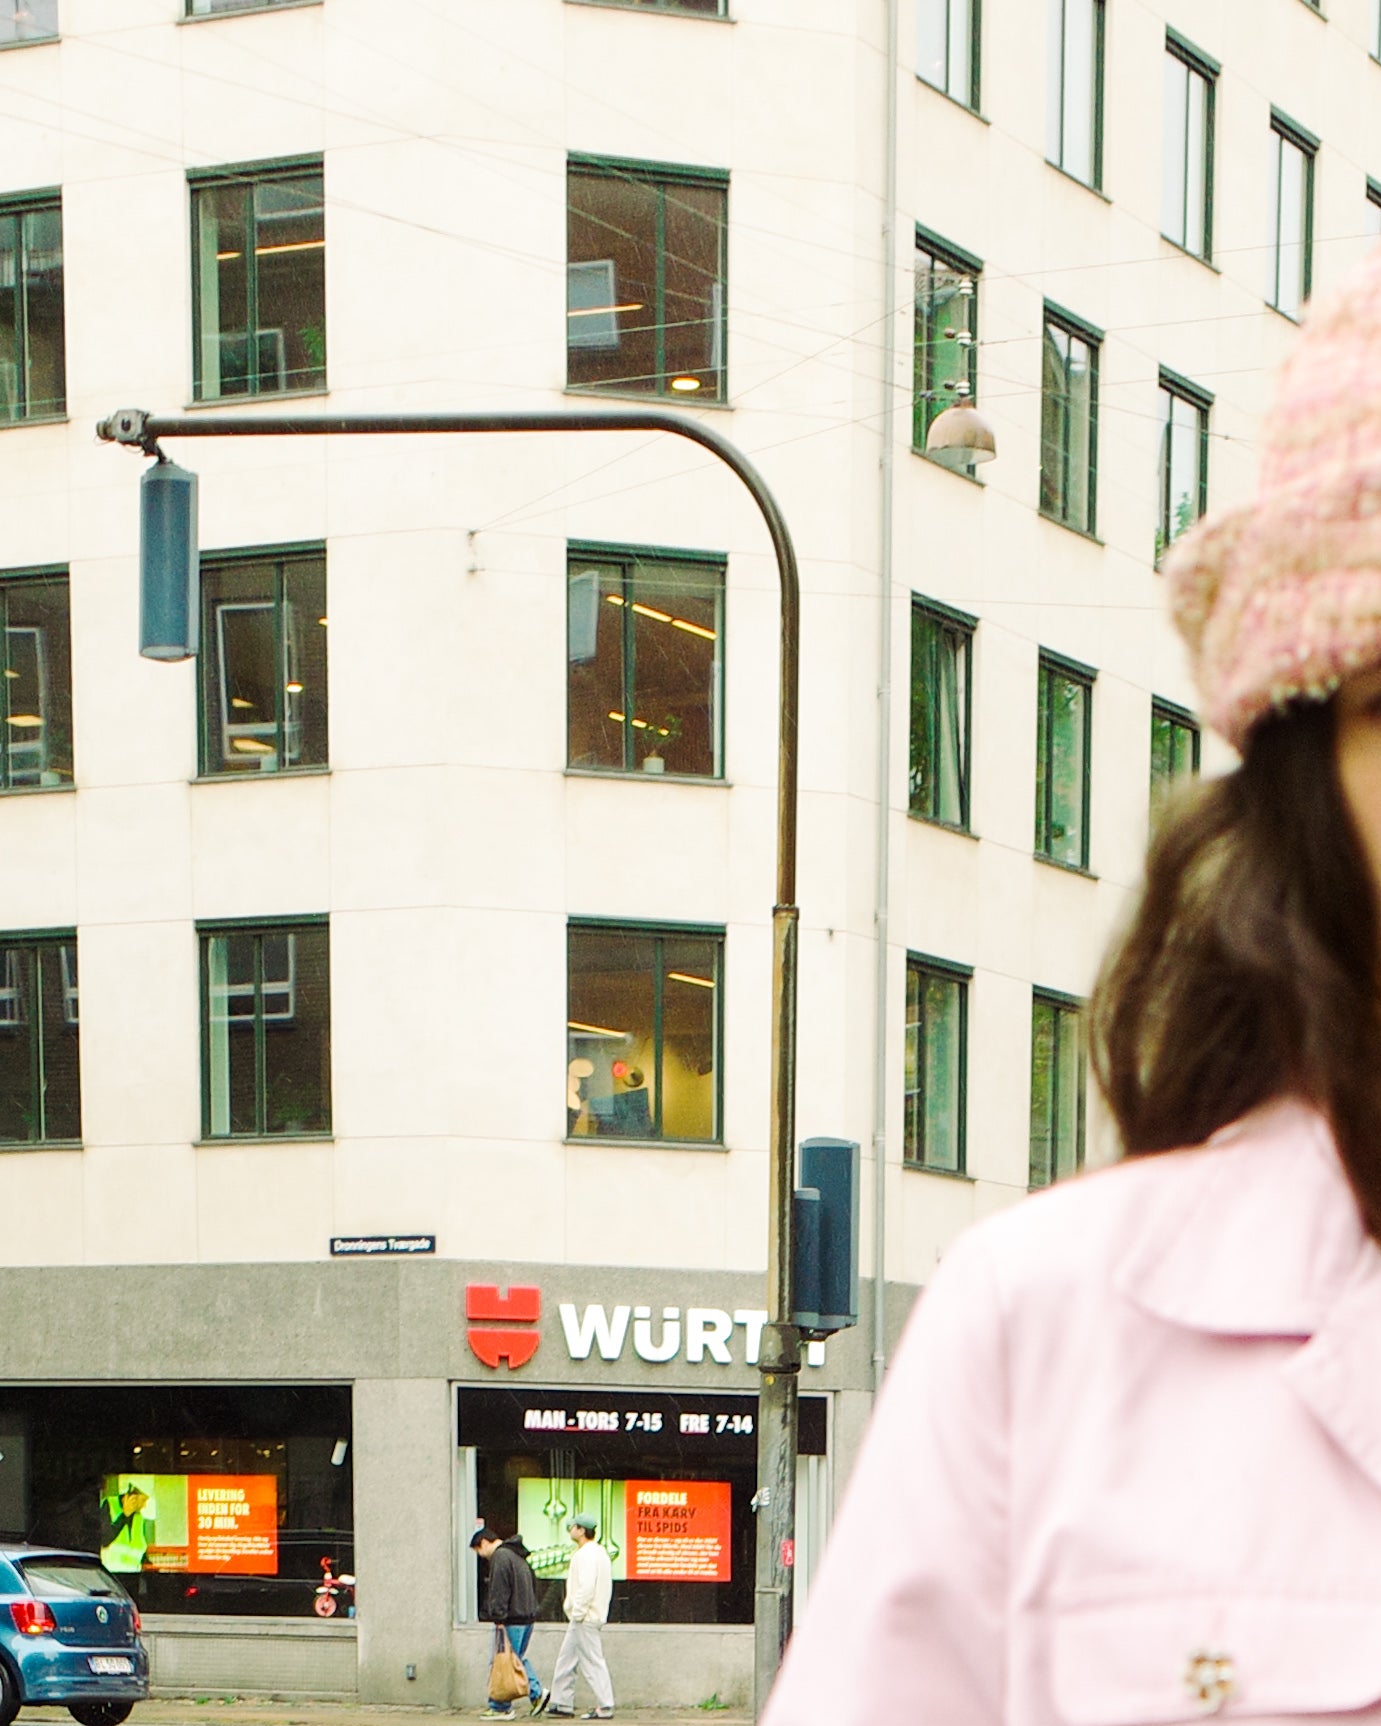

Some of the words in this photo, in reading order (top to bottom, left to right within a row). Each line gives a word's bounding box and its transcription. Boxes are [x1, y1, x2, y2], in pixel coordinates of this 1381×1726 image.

[558, 1303, 826, 1367] WÜRT
[625, 1413, 662, 1431] 7-15
[680, 1414, 709, 1433] FRE
[715, 1414, 753, 1434] 7-14
[197, 1488, 245, 1502] LEVERING
[637, 1491, 688, 1505] FORDELE
[230, 1503, 250, 1516] FOR
[639, 1507, 659, 1517] FRA
[638, 1522, 653, 1533] TIL
[656, 1521, 688, 1533] SPIDS
